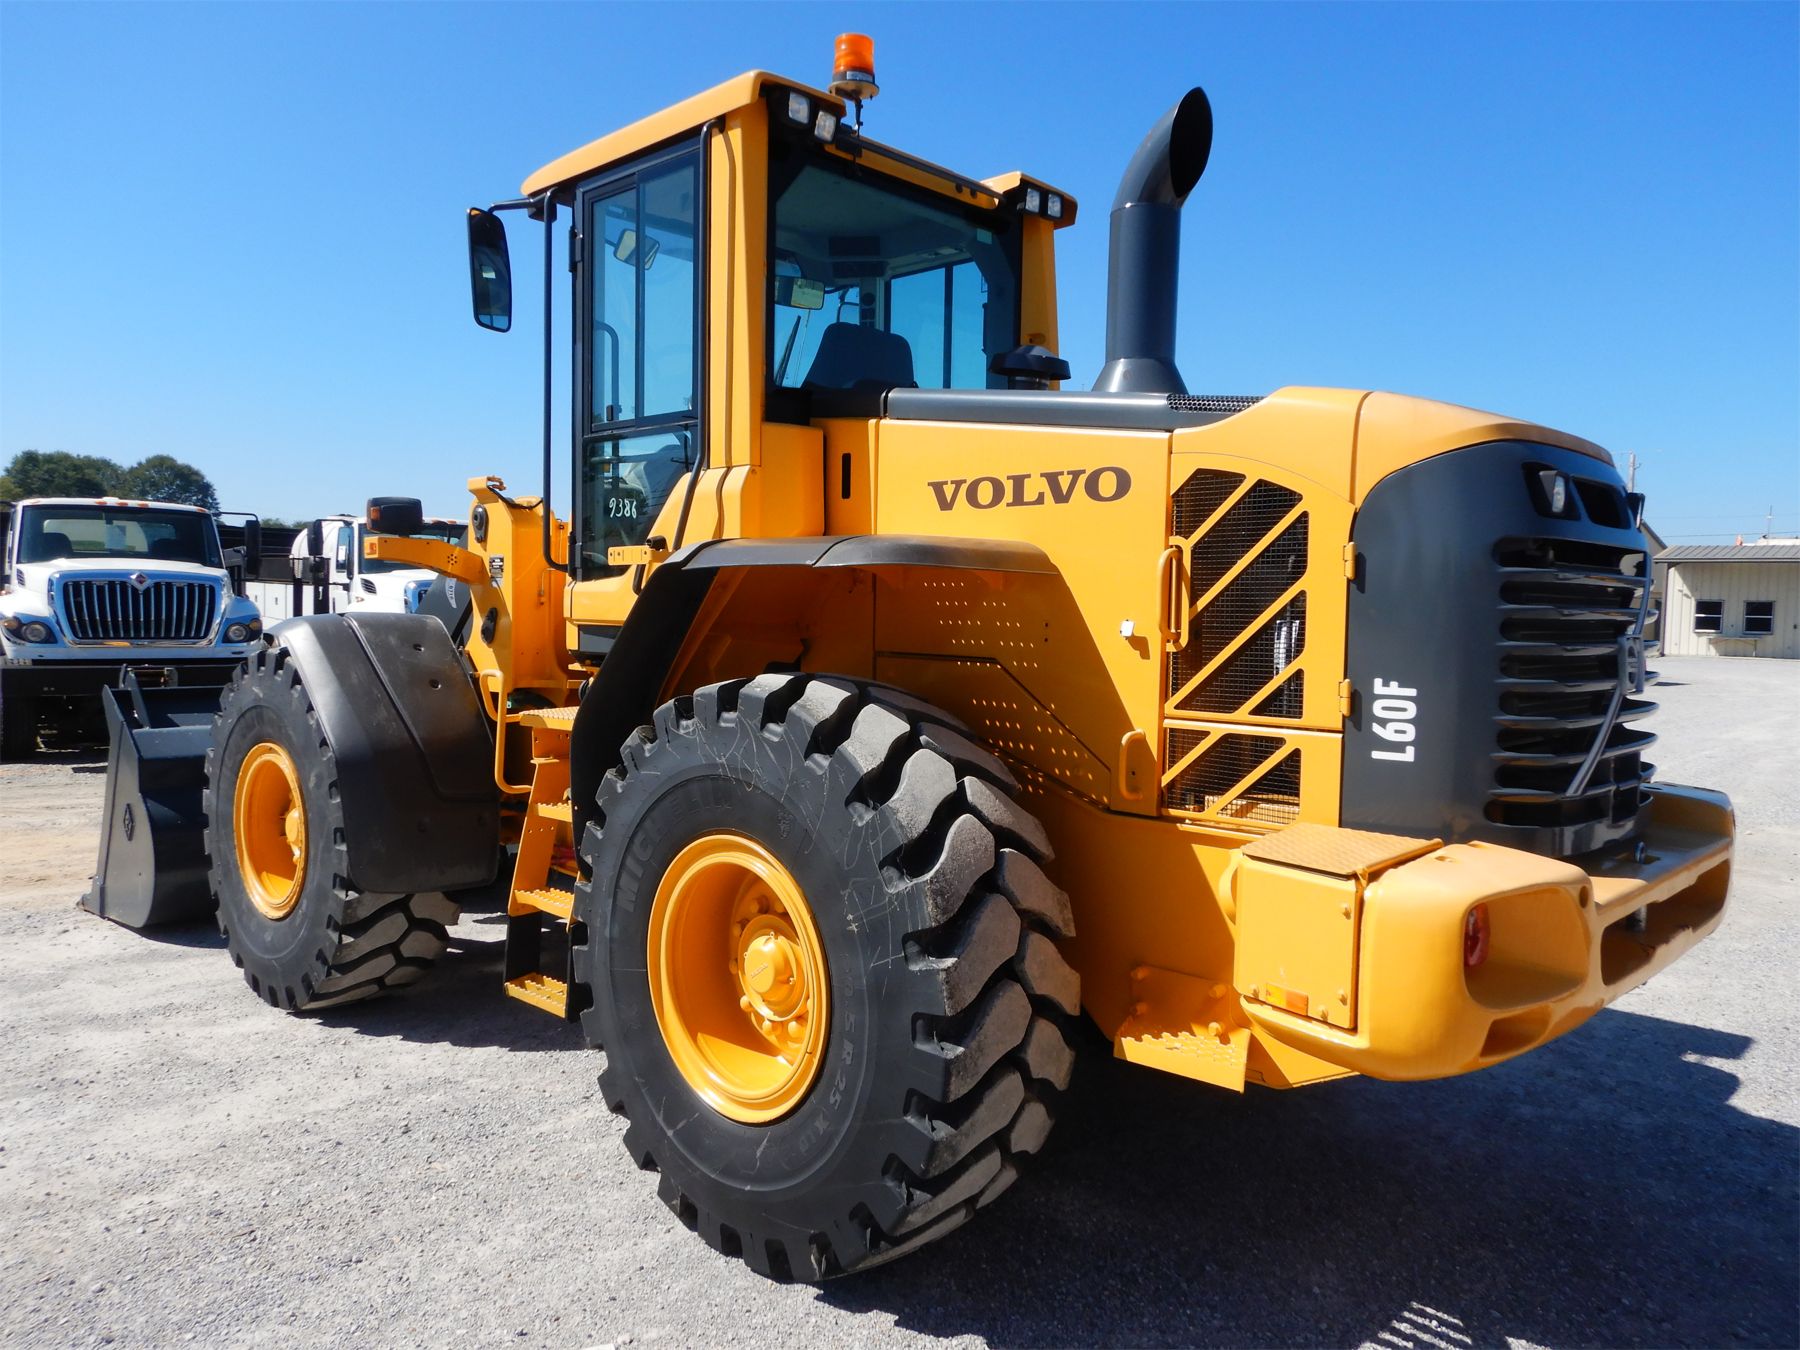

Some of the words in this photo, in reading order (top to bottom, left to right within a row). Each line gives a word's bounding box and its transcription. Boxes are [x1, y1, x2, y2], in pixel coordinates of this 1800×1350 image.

[608, 497, 638, 520] 9386
[927, 466, 1132, 512] VOLVO
[1371, 677, 1418, 763] L60F
